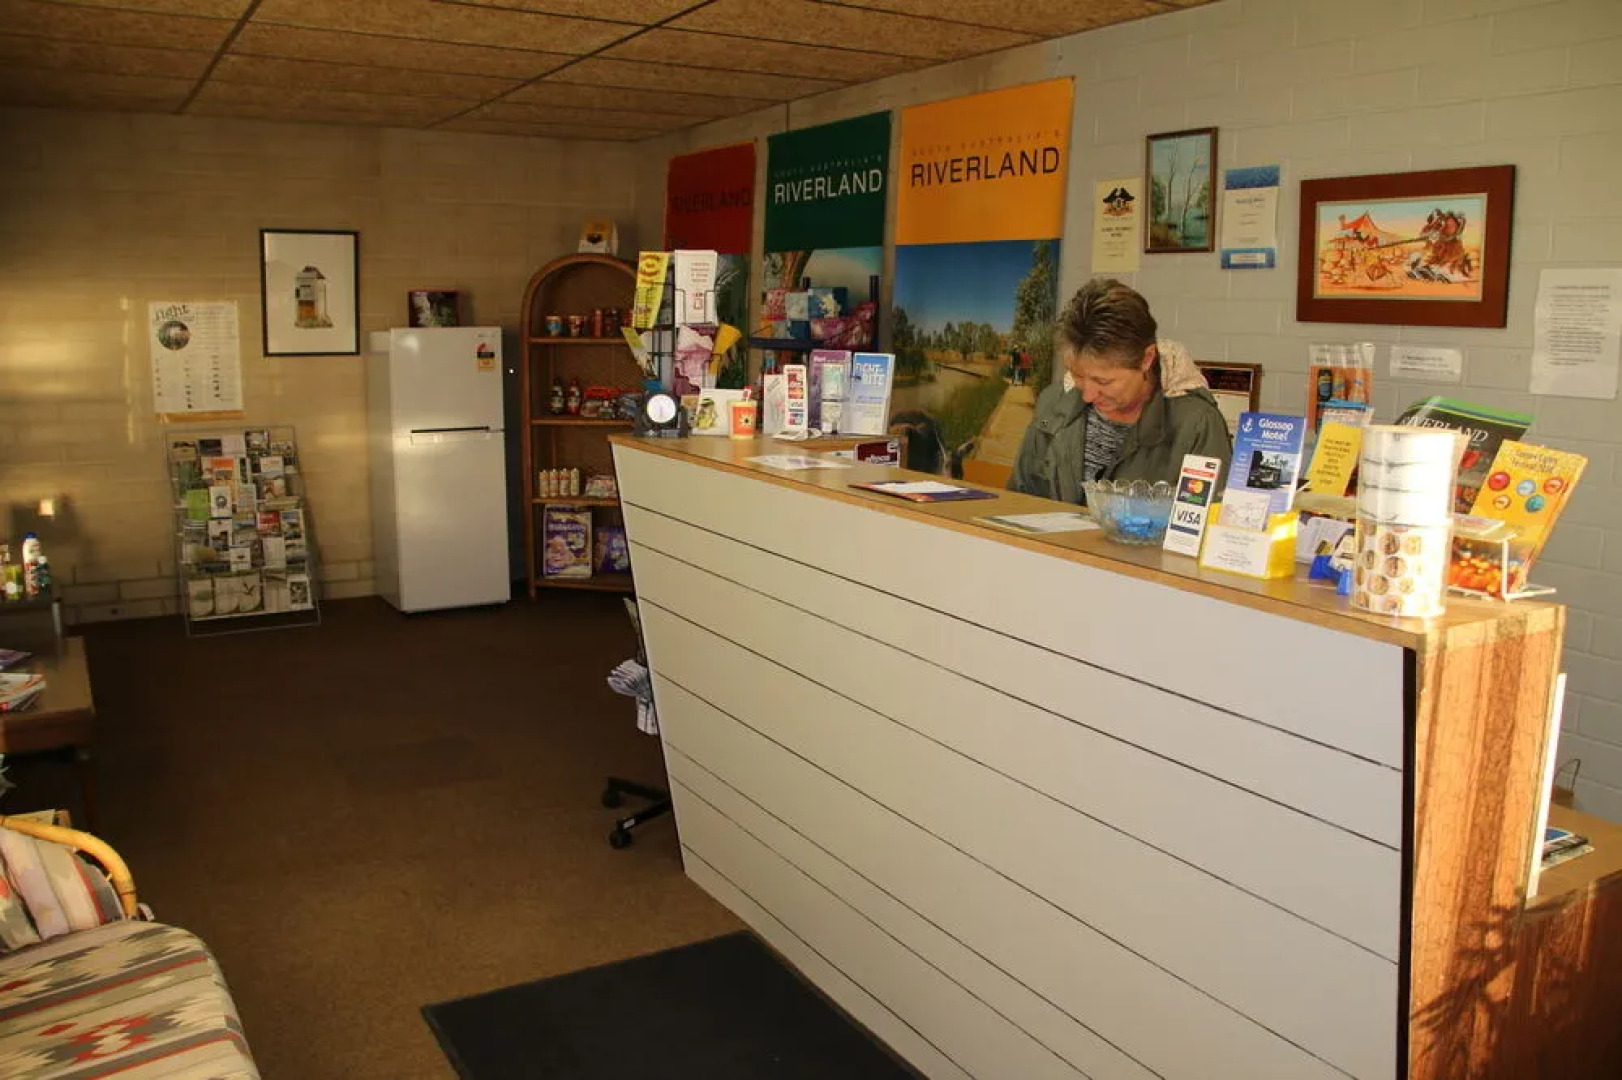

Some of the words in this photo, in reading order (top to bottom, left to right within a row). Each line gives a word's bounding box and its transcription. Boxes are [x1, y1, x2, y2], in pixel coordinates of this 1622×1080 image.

[911, 147, 1060, 188] RIVERLAND
[774, 169, 883, 205] RIVERLAND
[1258, 417, 1294, 431] Glossop
[1261, 429, 1290, 441] Motel
[1176, 510, 1201, 525] VISA
